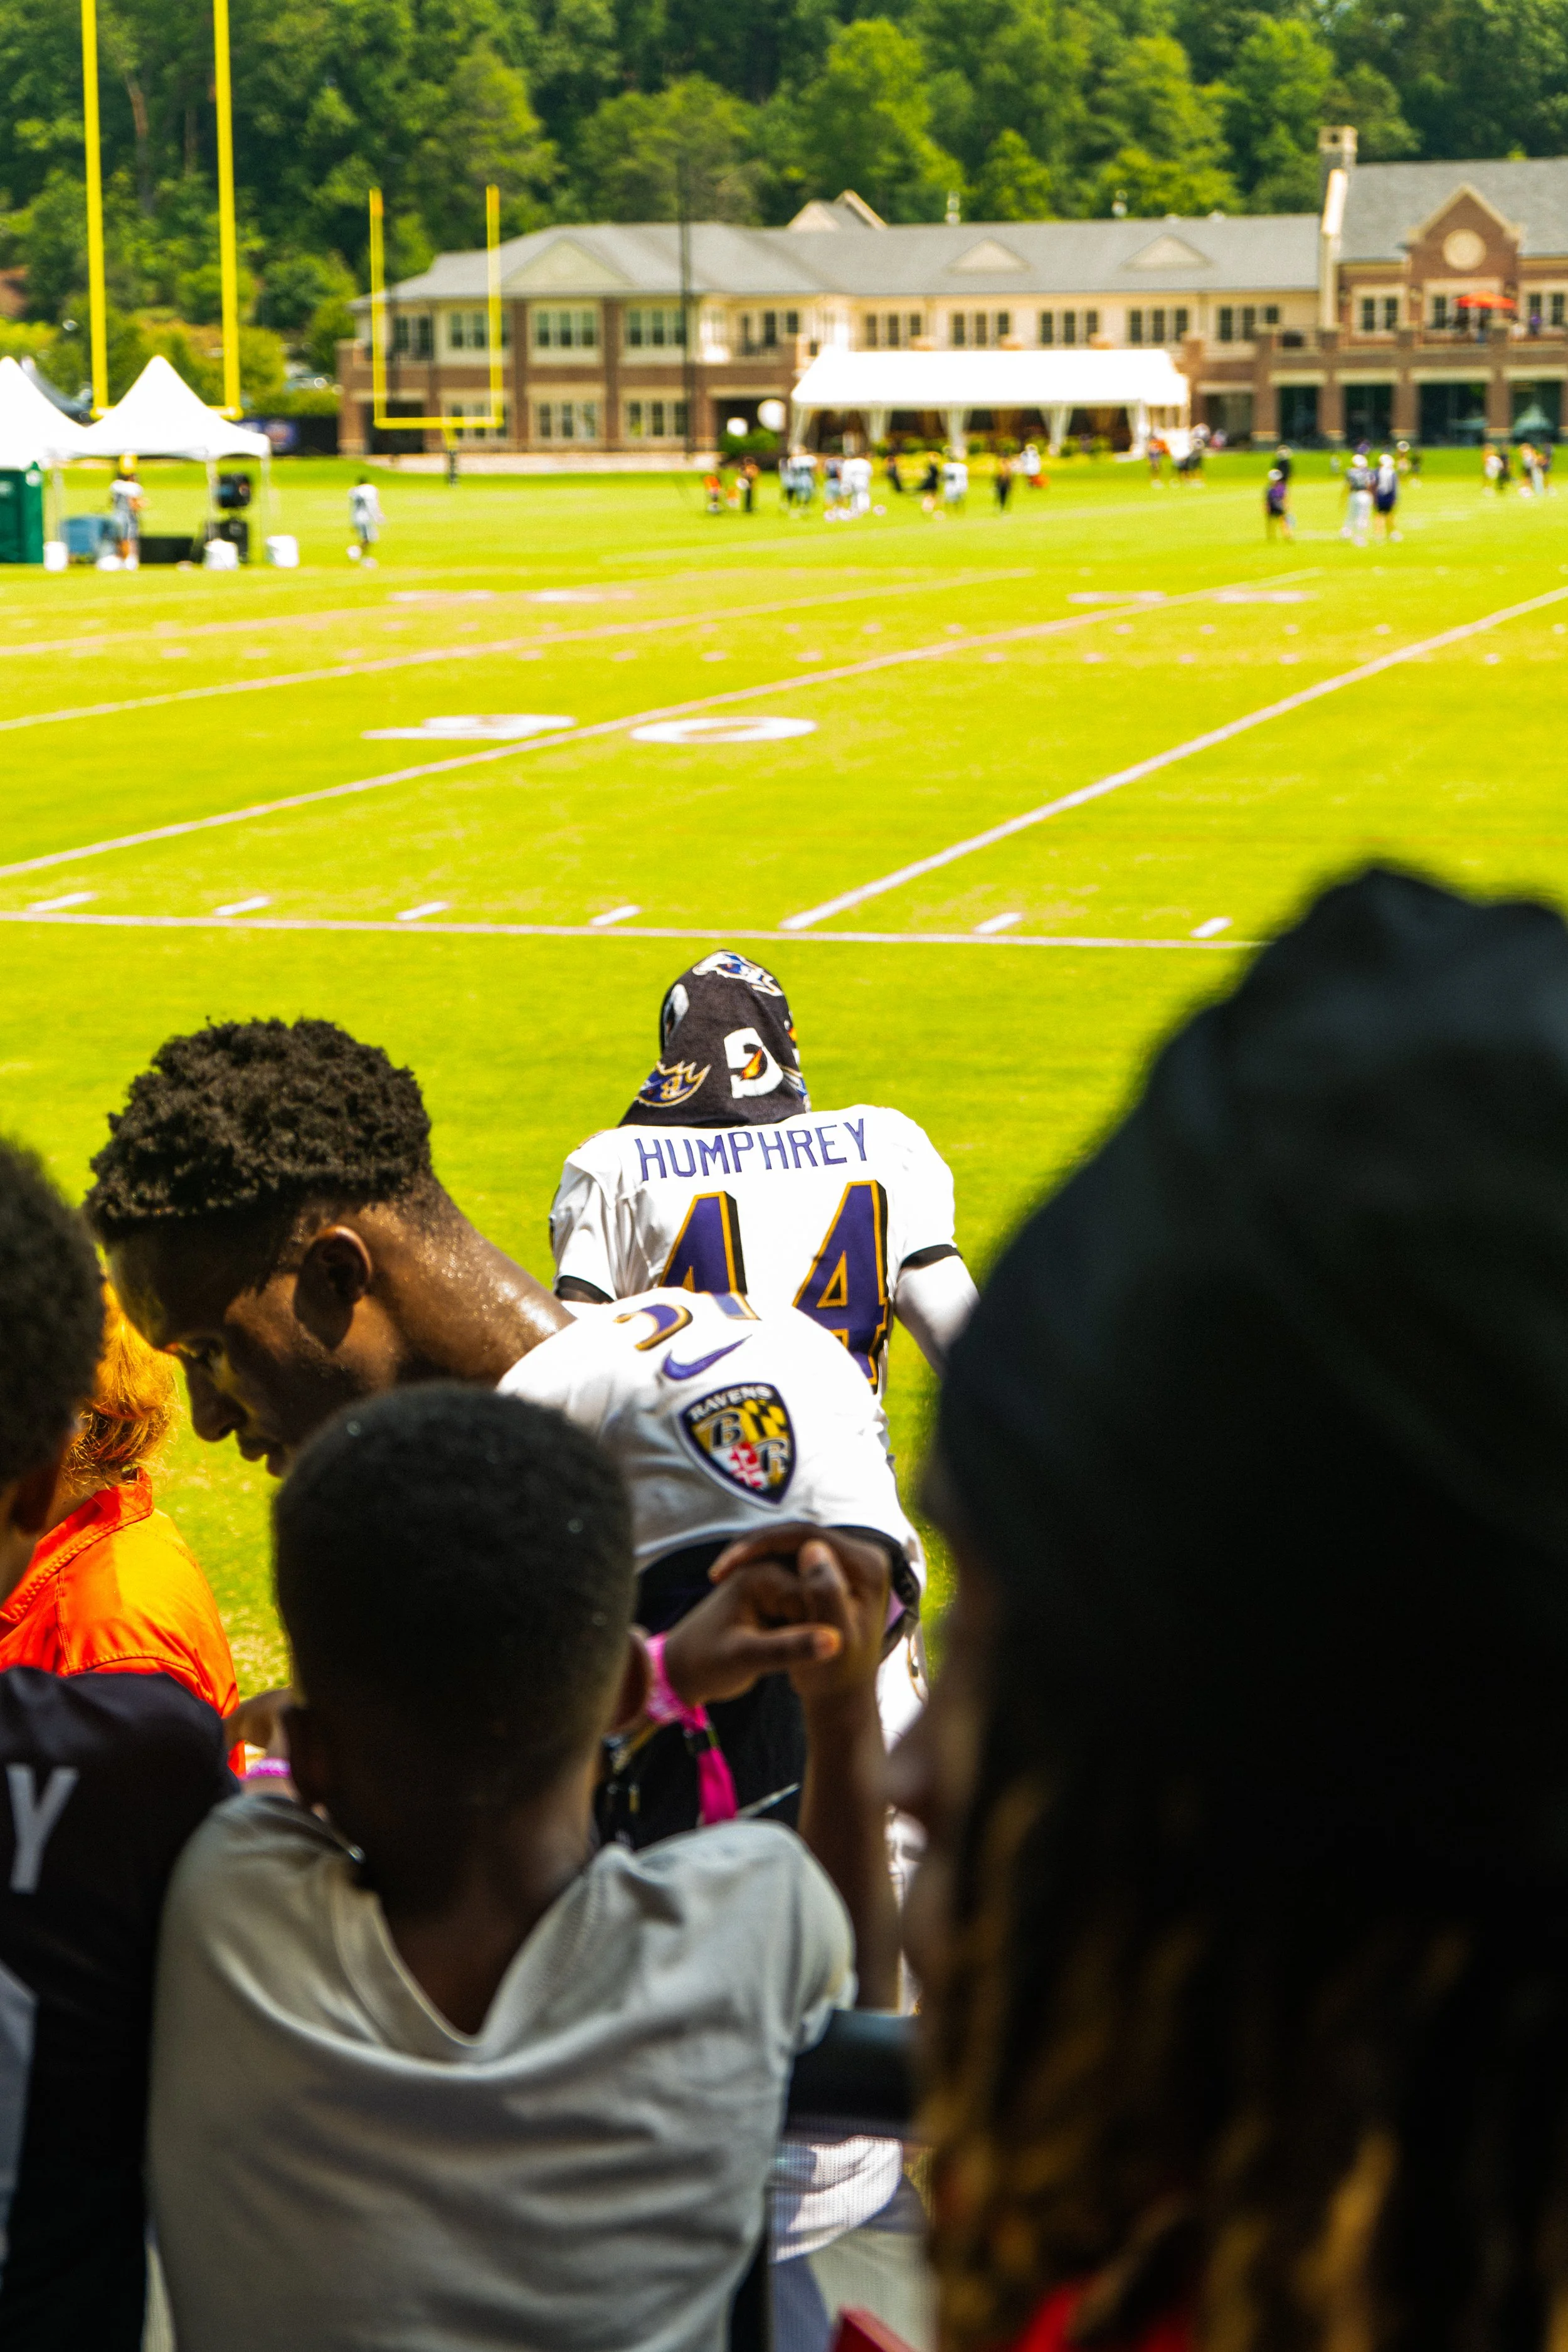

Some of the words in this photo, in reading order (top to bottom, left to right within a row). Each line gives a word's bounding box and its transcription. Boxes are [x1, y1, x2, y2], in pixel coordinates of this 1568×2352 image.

[634, 1118, 867, 1182] HUMPHREY
[688, 1385, 774, 1422] RAVENS
[5, 1762, 80, 1895] Y
